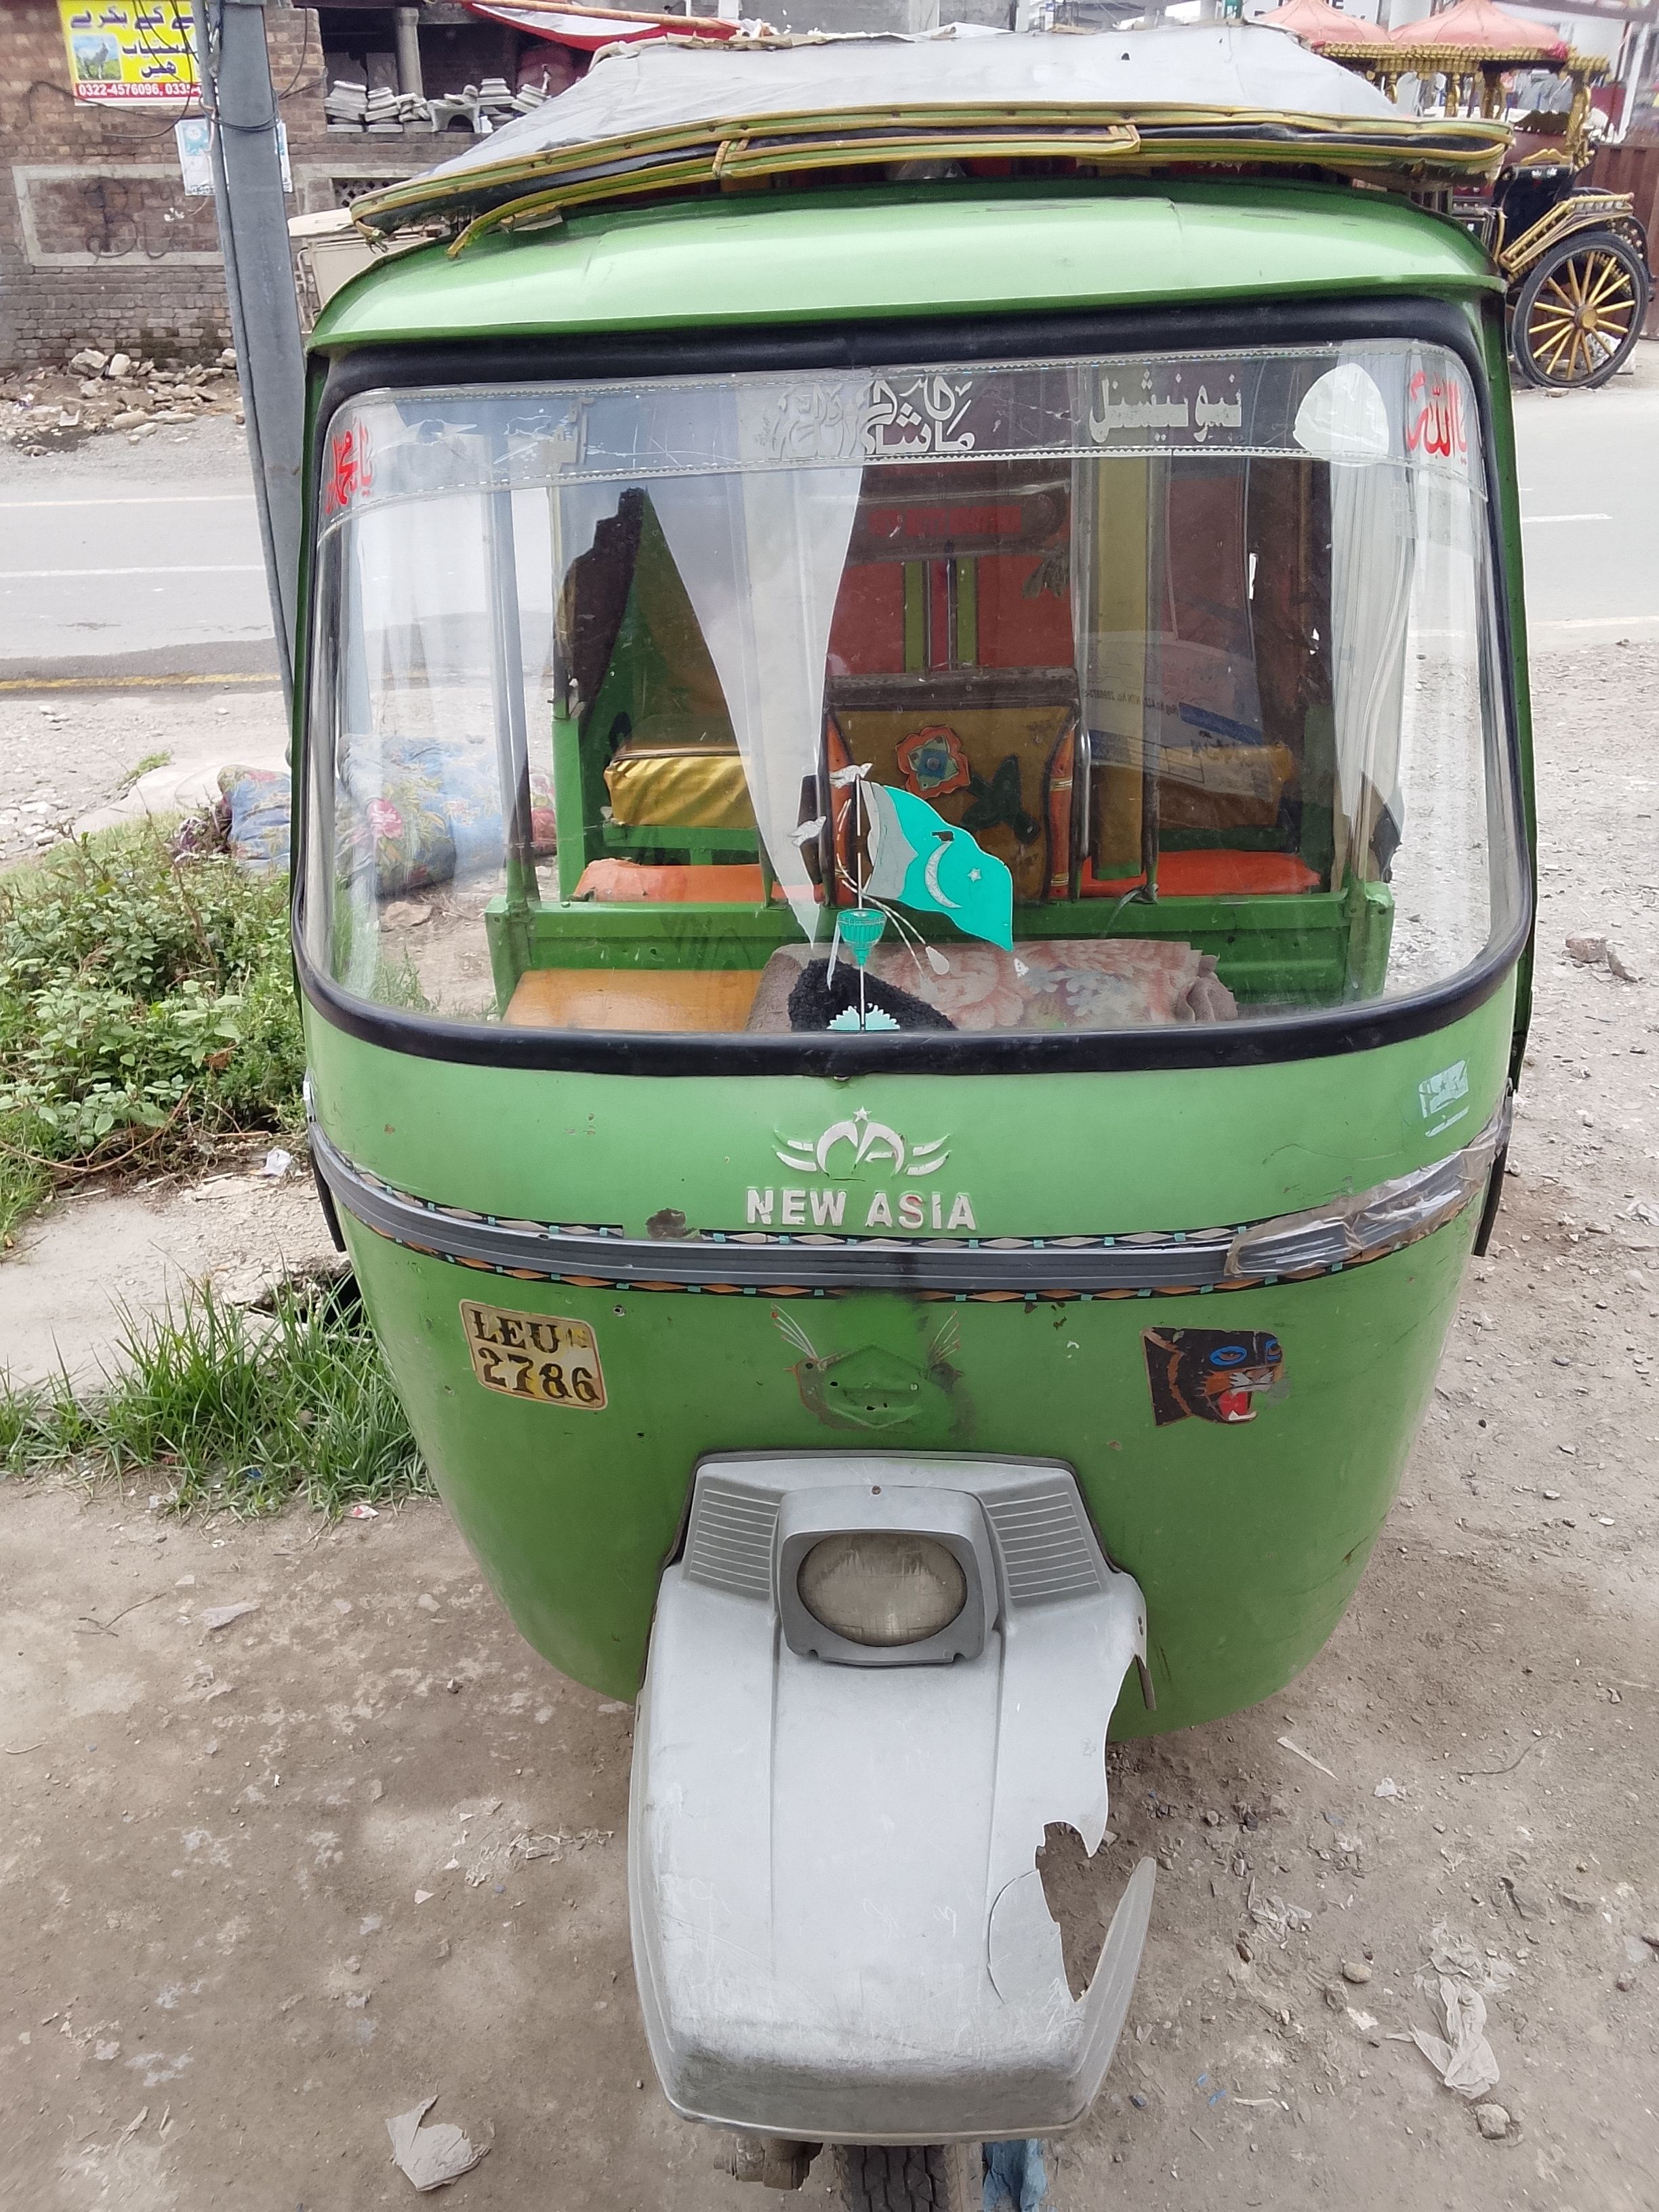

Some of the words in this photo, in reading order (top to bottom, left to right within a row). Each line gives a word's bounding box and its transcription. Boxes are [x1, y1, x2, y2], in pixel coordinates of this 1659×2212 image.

[746, 1187, 847, 1226] NEW
[865, 1191, 977, 1231] ASIA
[469, 1308, 560, 1354] LEU
[477, 1346, 601, 1404] 2786
